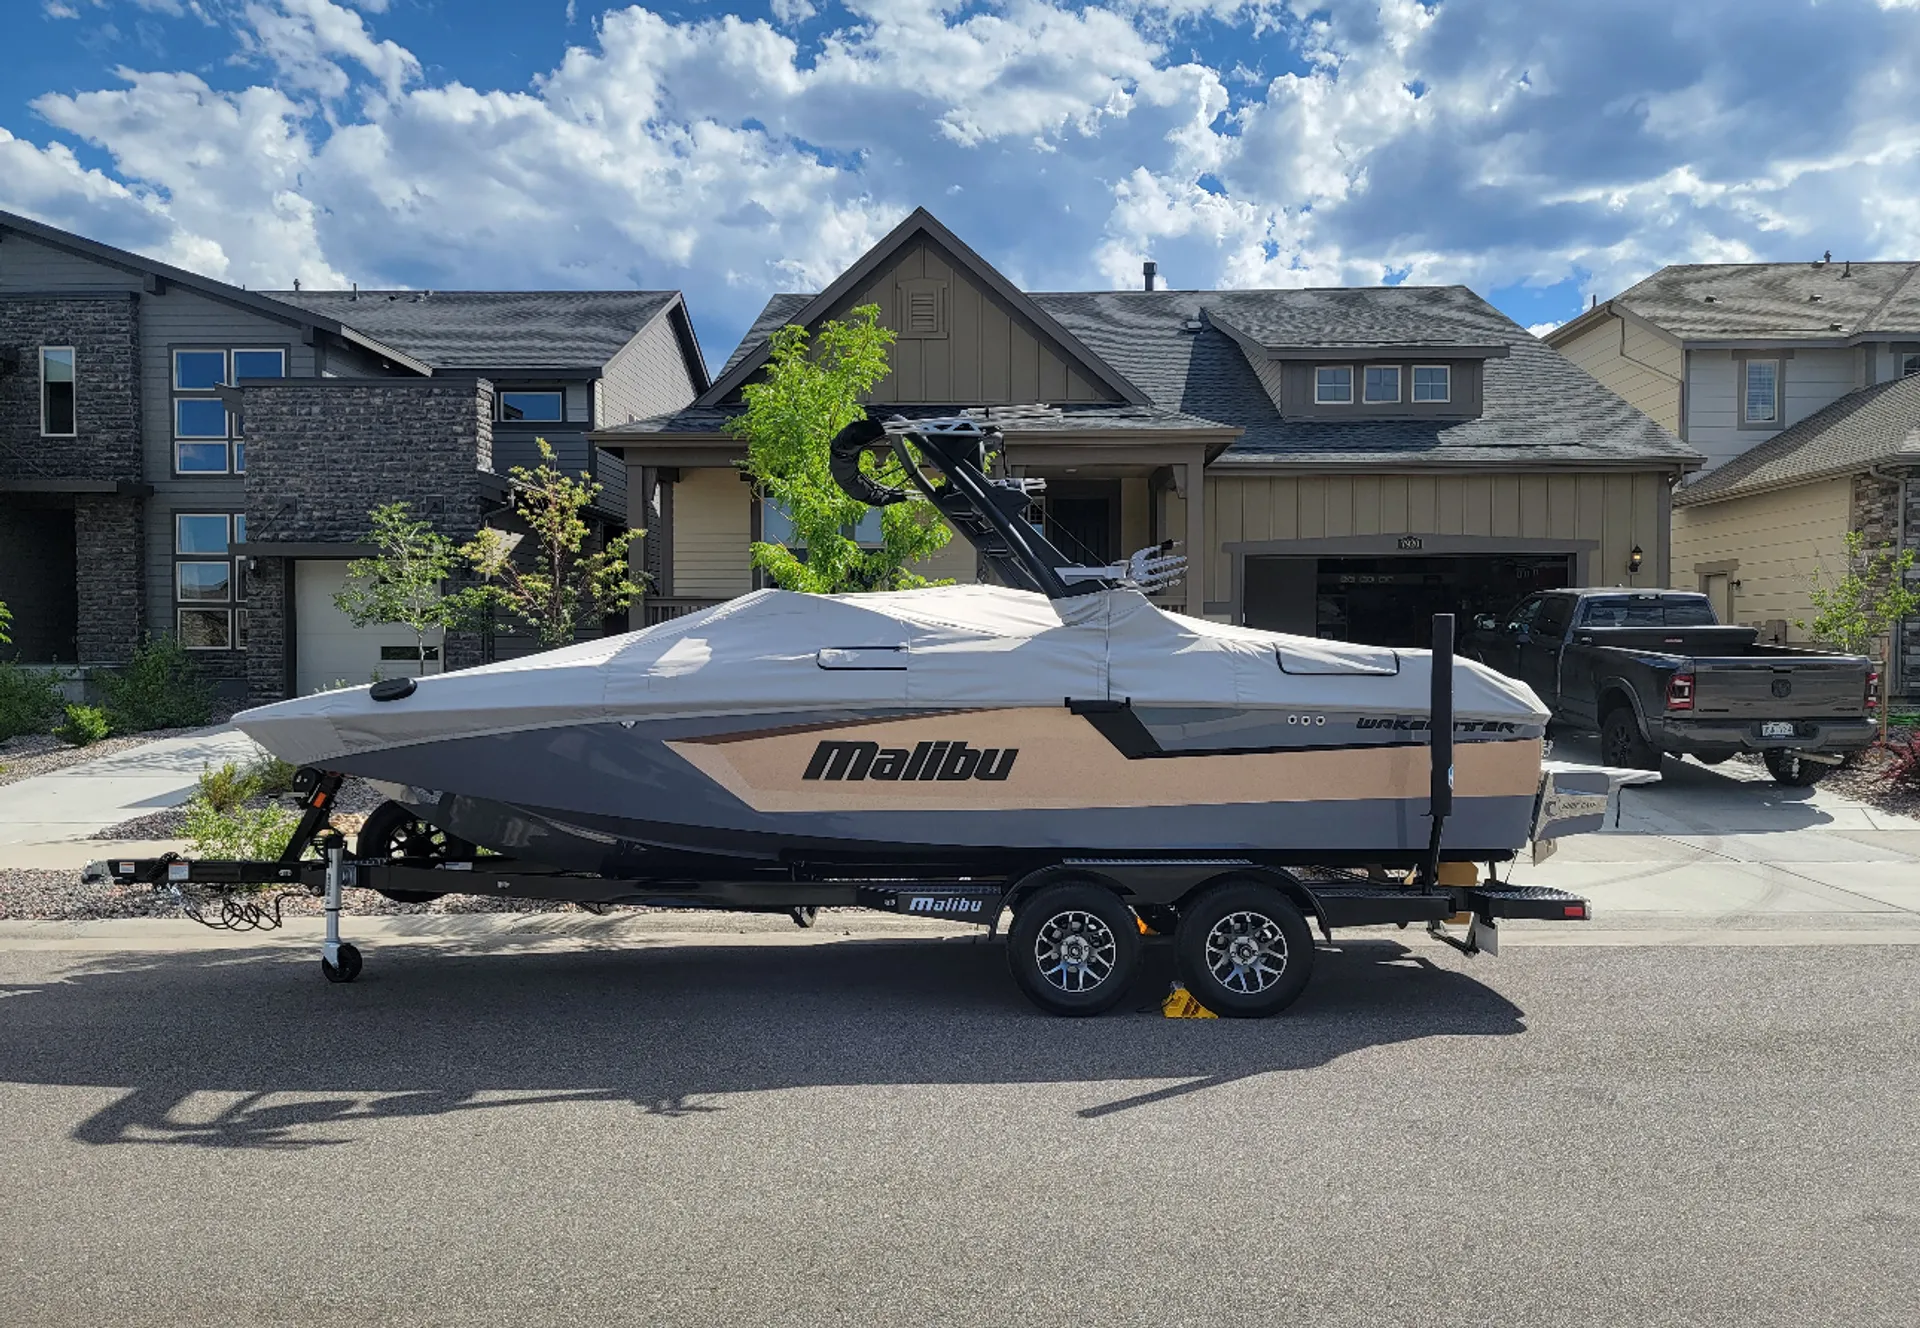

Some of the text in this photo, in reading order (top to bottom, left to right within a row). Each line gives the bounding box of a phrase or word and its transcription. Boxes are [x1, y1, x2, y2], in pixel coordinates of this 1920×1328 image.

[1356, 718, 1515, 734] WAKETTER
[802, 740, 1020, 781] Malibu
[909, 897, 983, 912] Malibu
